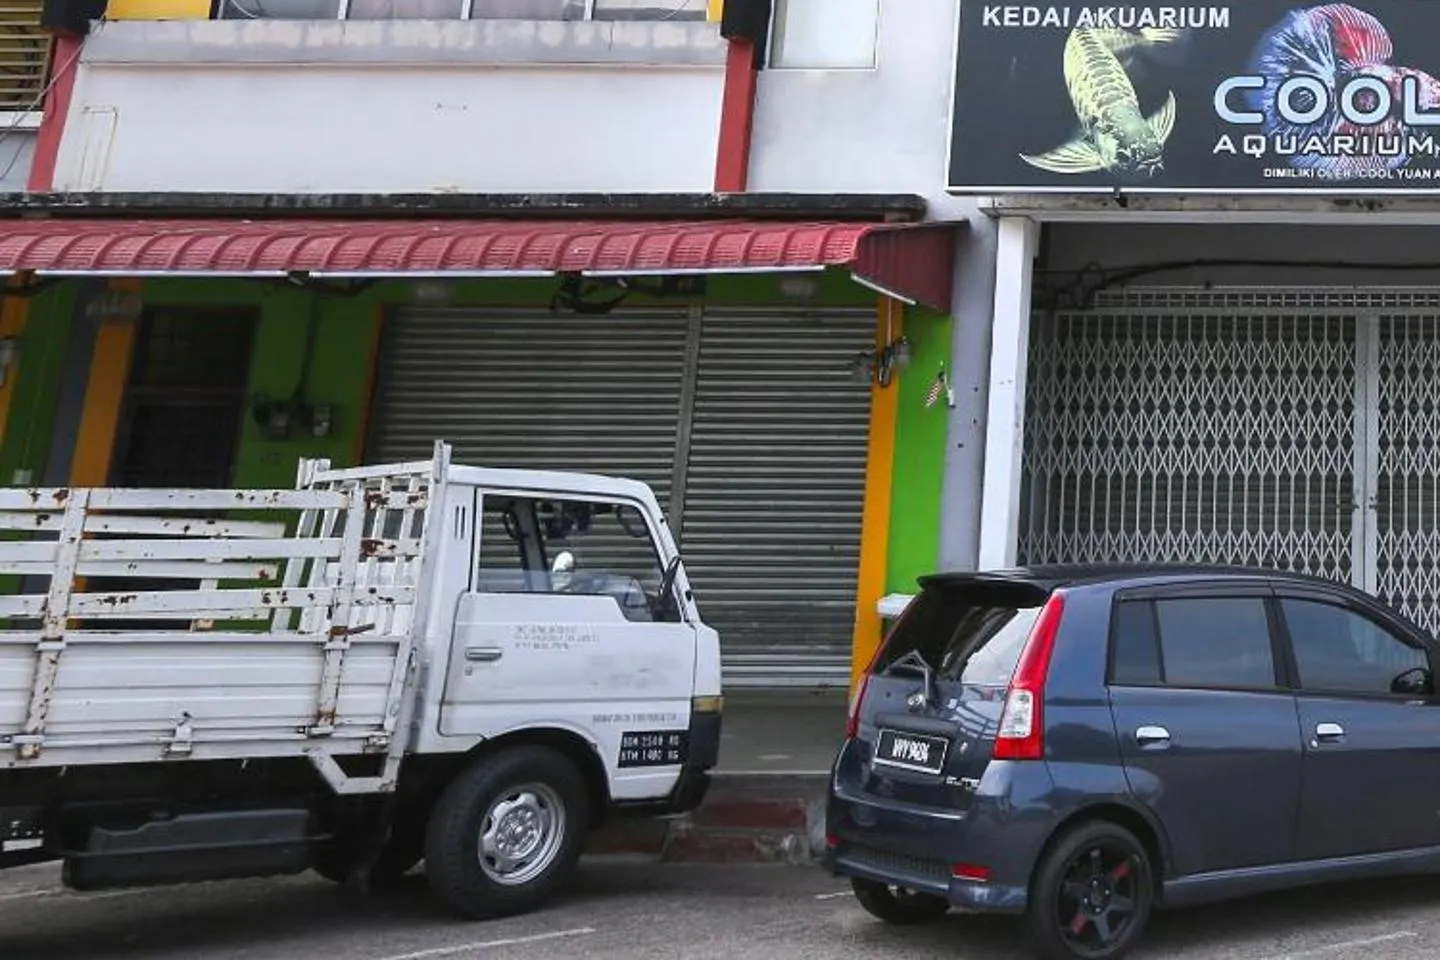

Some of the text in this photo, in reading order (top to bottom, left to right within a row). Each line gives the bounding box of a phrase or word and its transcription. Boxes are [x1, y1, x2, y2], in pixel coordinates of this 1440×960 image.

[982, 6, 1230, 28] KEDAI AKUARIUM
[1212, 135, 1436, 157] AQUARIUM
[1263, 168, 1315, 178] DIMILIKI
[1358, 168, 1394, 179] COOL
[1396, 168, 1431, 179] YUAN
